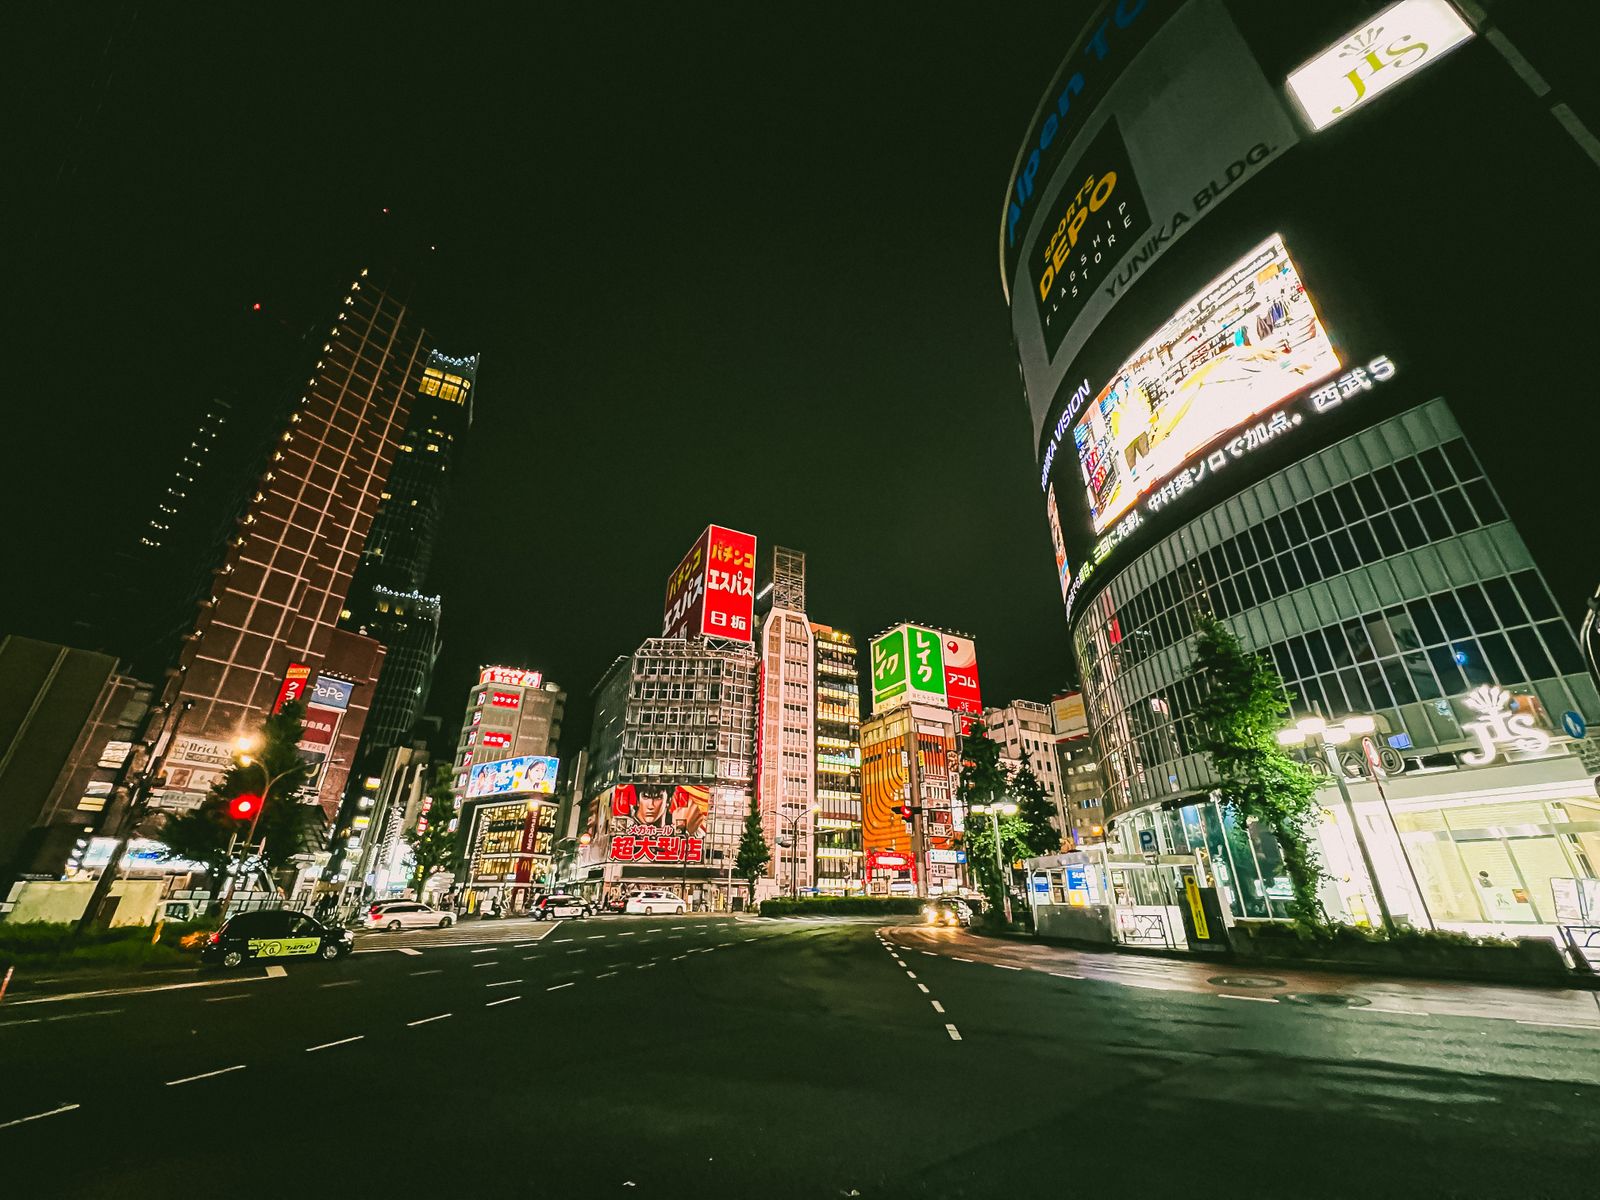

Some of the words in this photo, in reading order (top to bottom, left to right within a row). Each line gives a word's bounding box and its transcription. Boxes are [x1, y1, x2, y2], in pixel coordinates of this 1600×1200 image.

[1039, 170, 1118, 303] DEPO
[1044, 173, 1095, 264] SPORTS
[1105, 211, 1190, 299] YUNIKA
[1193, 142, 1277, 212] BLDG.
[1046, 201, 1127, 327] FLAGSHIP
[1070, 214, 1132, 298] STORE
[1054, 378, 1091, 442] VISION
[668, 547, 702, 601] パチンコ
[711, 542, 754, 569] パチンコ
[662, 572, 704, 638] エスパス
[708, 569, 753, 598] エスパス
[875, 644, 899, 680] レイク
[916, 631, 933, 683] レイク
[947, 672, 977, 689] アコム
[188, 742, 219, 756] Brick
[609, 836, 703, 862] 超大型店
[626, 824, 674, 837] メガホール
